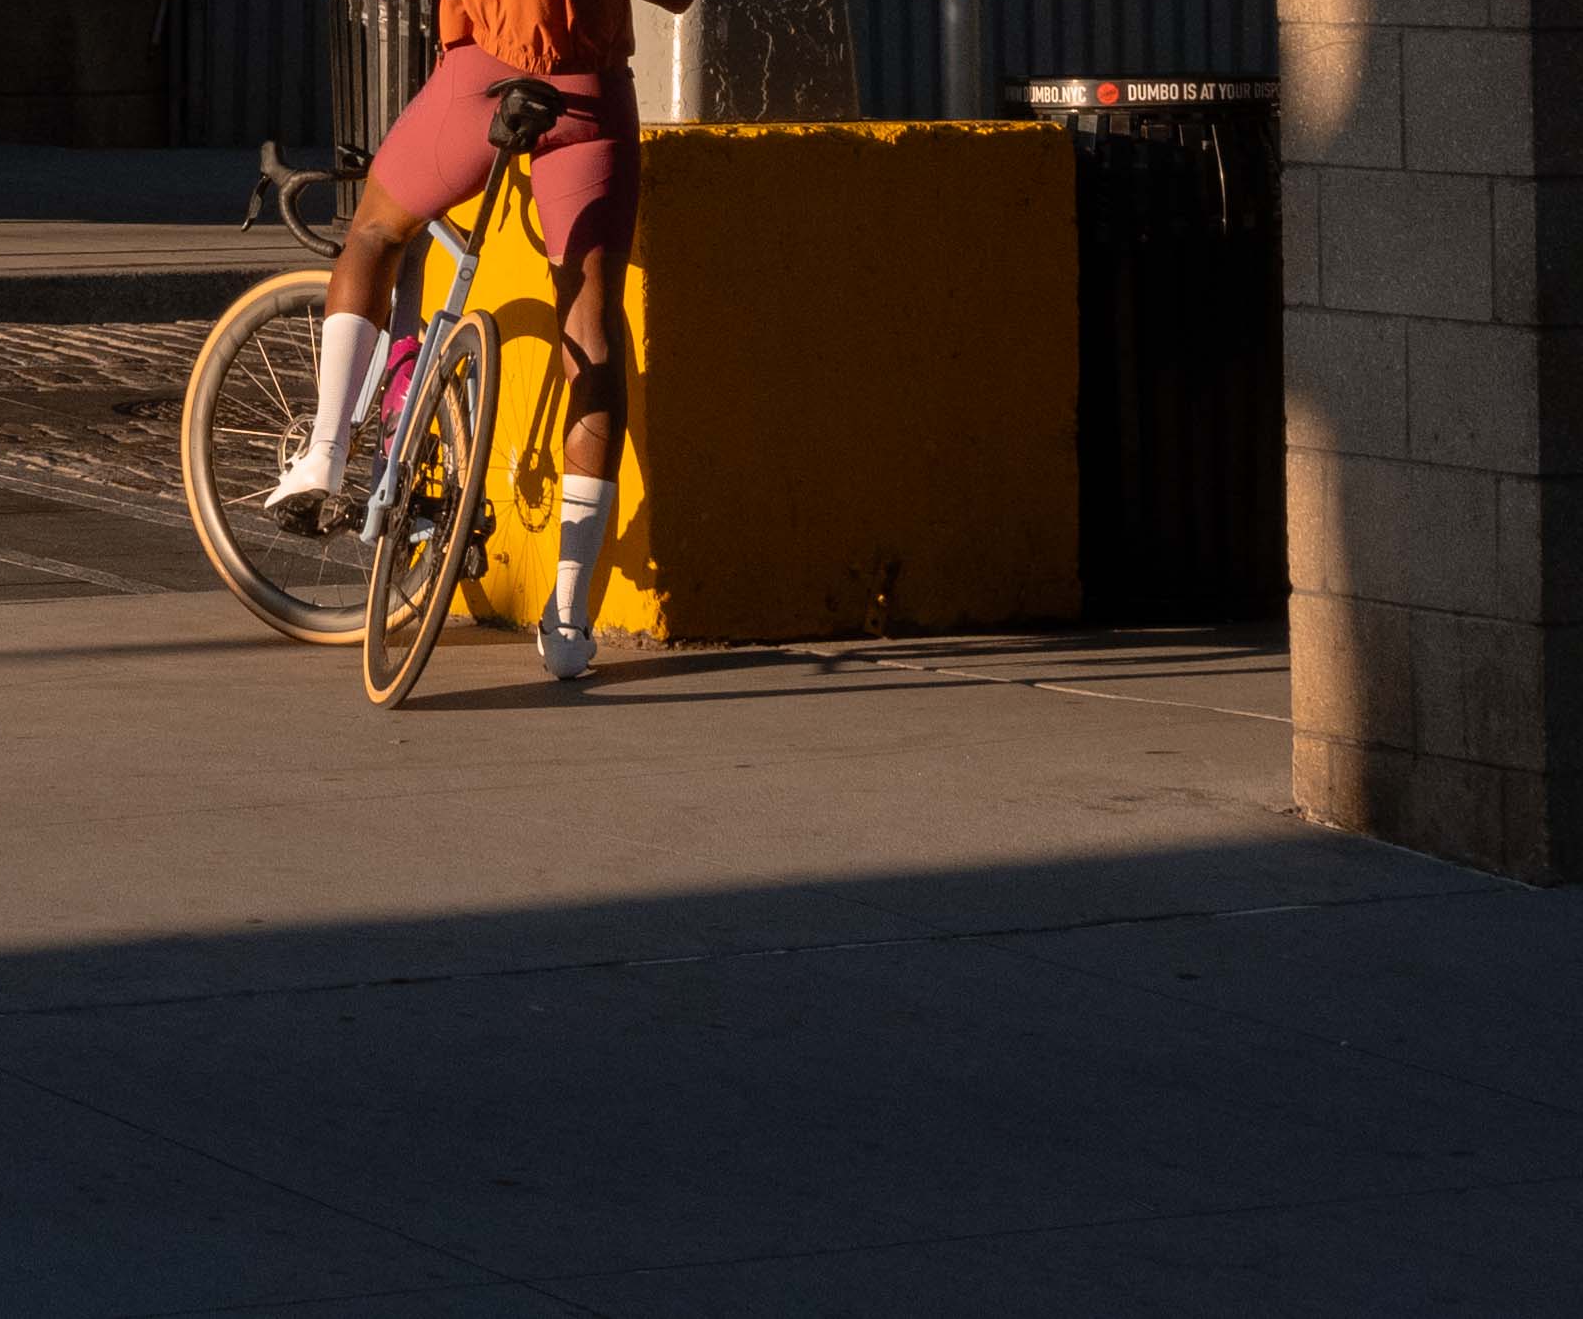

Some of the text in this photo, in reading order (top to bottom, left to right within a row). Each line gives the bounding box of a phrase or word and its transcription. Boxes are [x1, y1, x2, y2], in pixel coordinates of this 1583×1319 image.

[1127, 83, 1178, 102] DUMBO
[1183, 83, 1197, 100] IS
[1200, 82, 1217, 100] AT
[1219, 82, 1251, 100] YOUR
